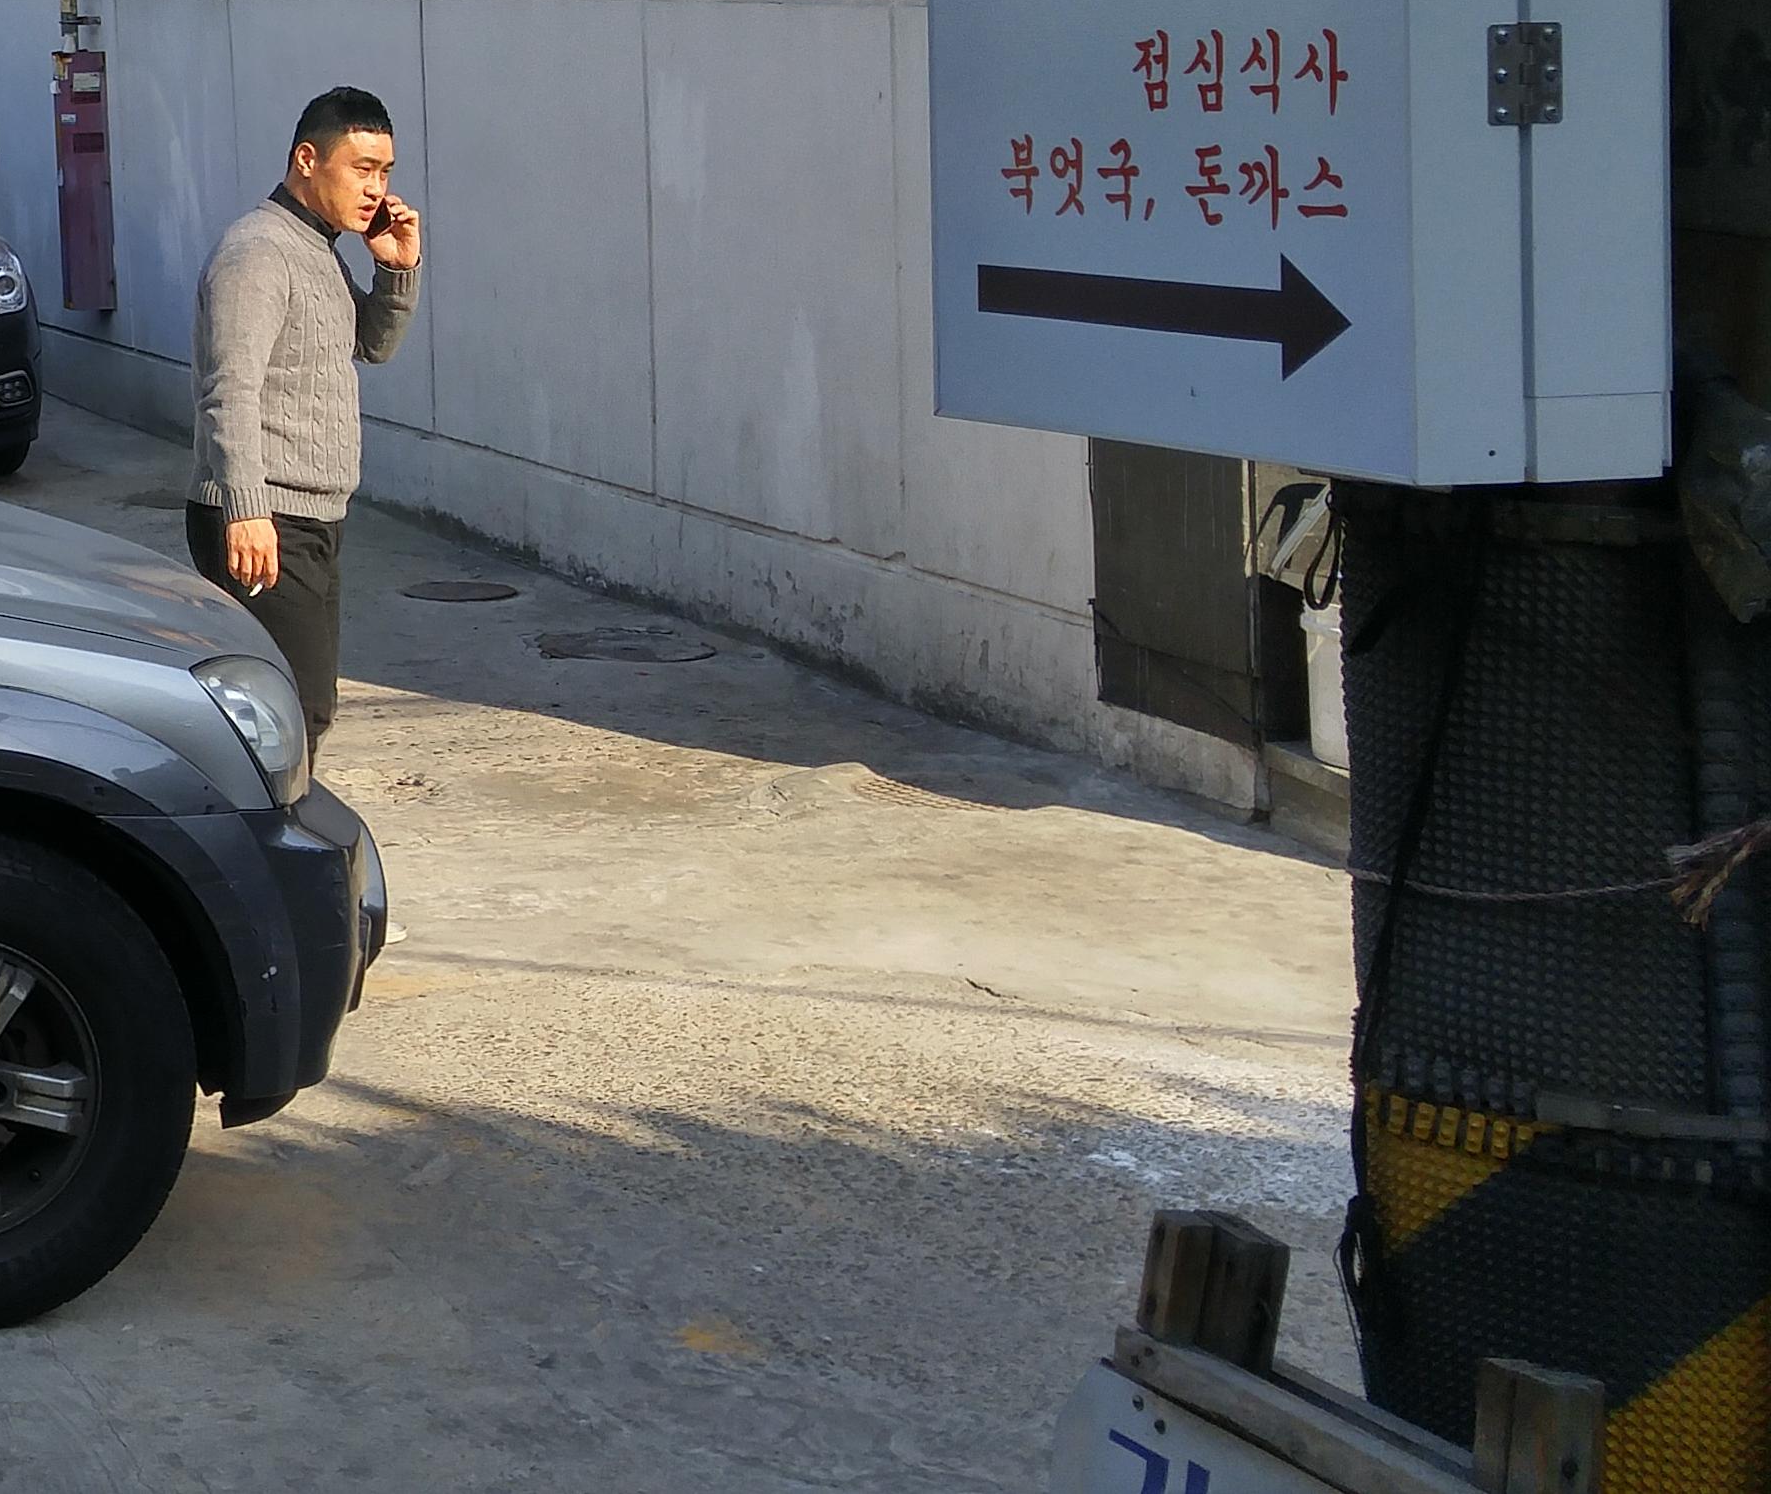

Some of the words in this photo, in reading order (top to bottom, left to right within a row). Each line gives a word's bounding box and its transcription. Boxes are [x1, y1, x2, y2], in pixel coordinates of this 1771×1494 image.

[1132, 29, 1350, 116] 점심식사
[1000, 134, 1156, 222] 북엇국,
[1185, 144, 1348, 231] 돈까스
